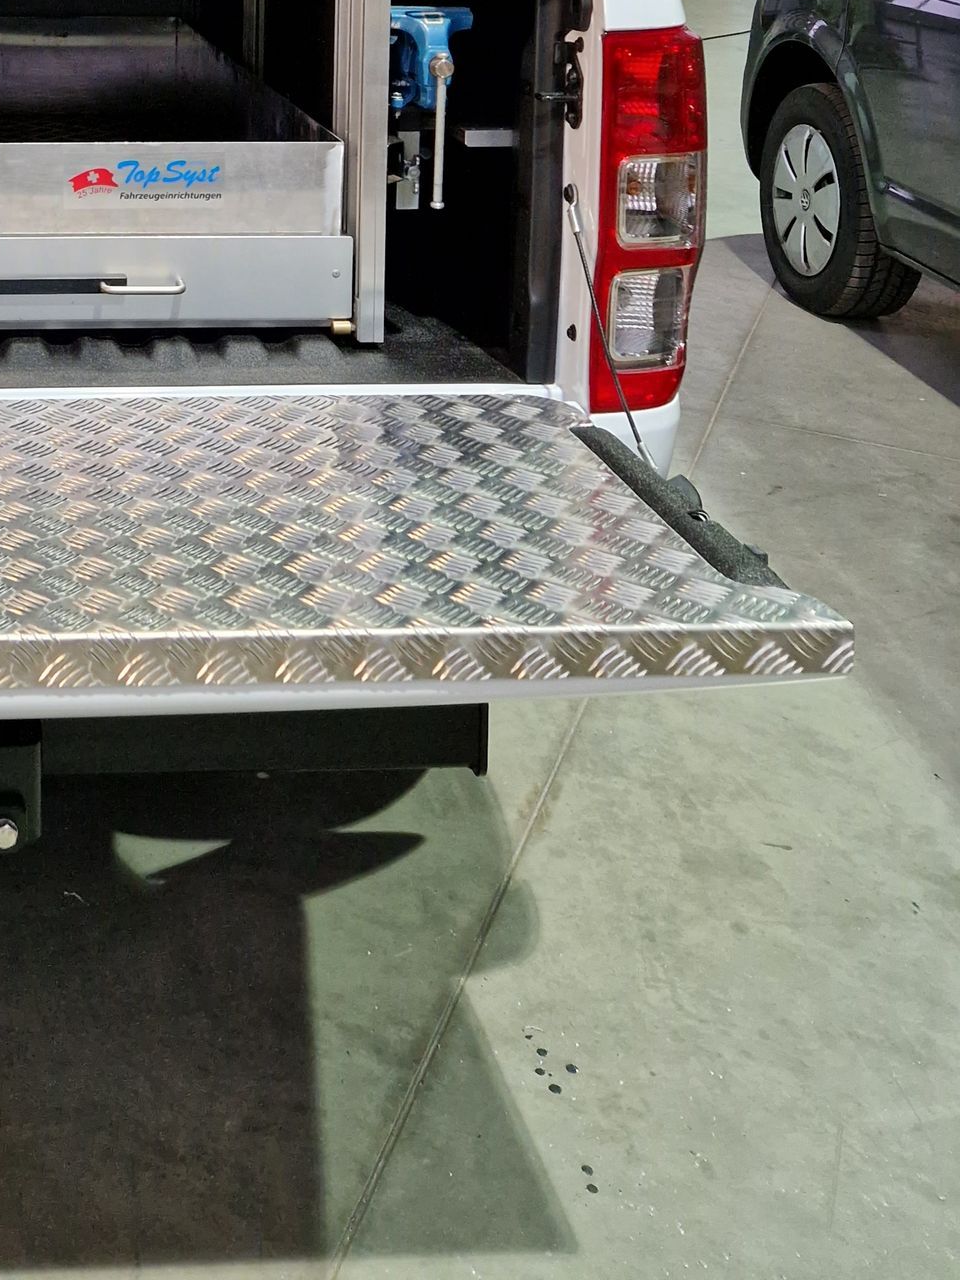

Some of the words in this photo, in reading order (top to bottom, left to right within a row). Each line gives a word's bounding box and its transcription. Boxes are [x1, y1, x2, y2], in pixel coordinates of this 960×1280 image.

[117, 160, 220, 188] TopSyst
[77, 189, 87, 199] 25
[119, 191, 222, 201] Fahrzeugeinrichtungen
